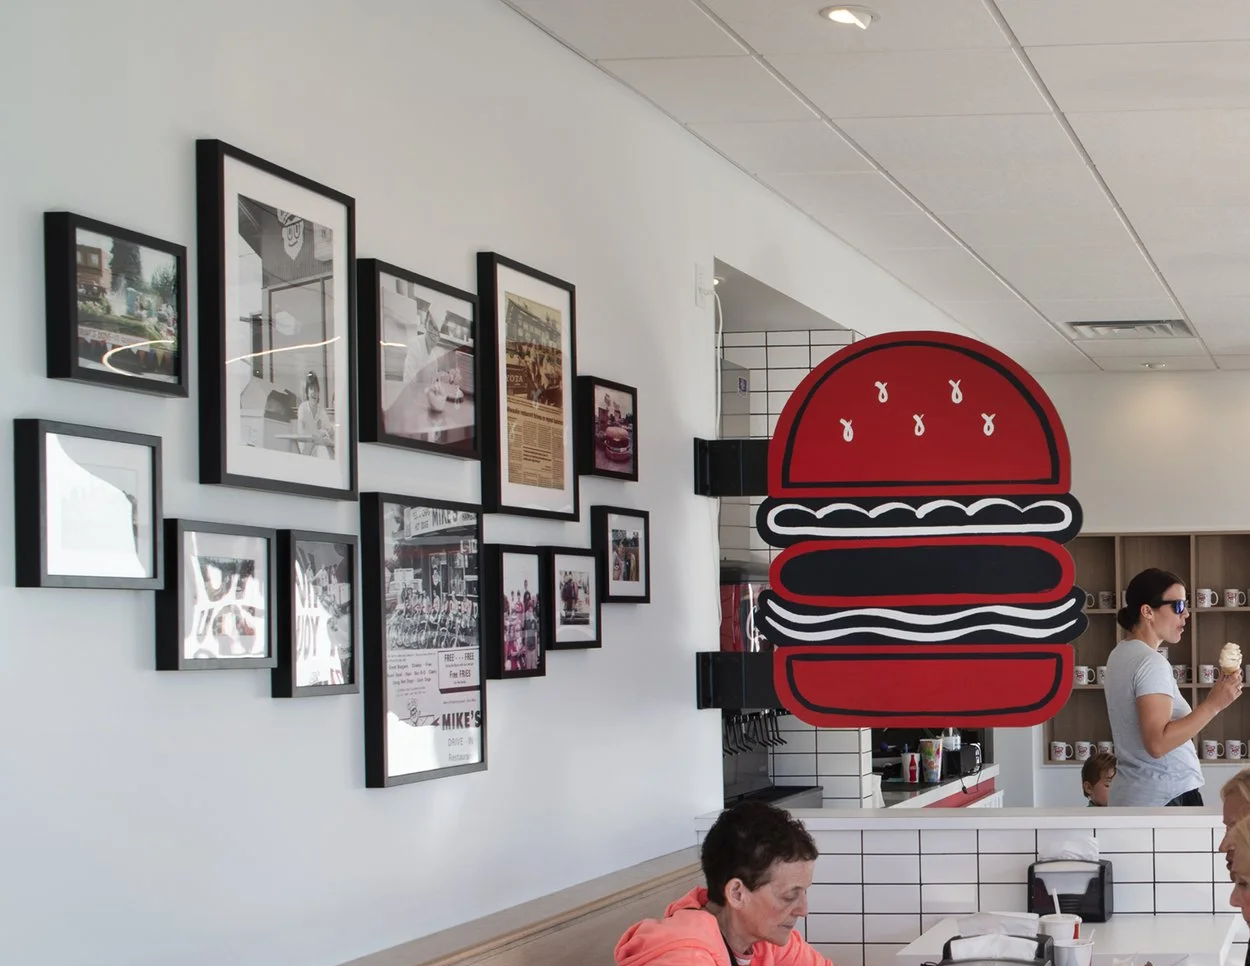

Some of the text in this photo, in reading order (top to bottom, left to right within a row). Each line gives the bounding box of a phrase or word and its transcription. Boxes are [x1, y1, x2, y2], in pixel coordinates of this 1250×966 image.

[444, 653, 455, 662] FREE
[464, 652, 475, 661] FREE
[449, 669, 471, 679] Free FRIES
[441, 711, 481, 730] MIKE'S
